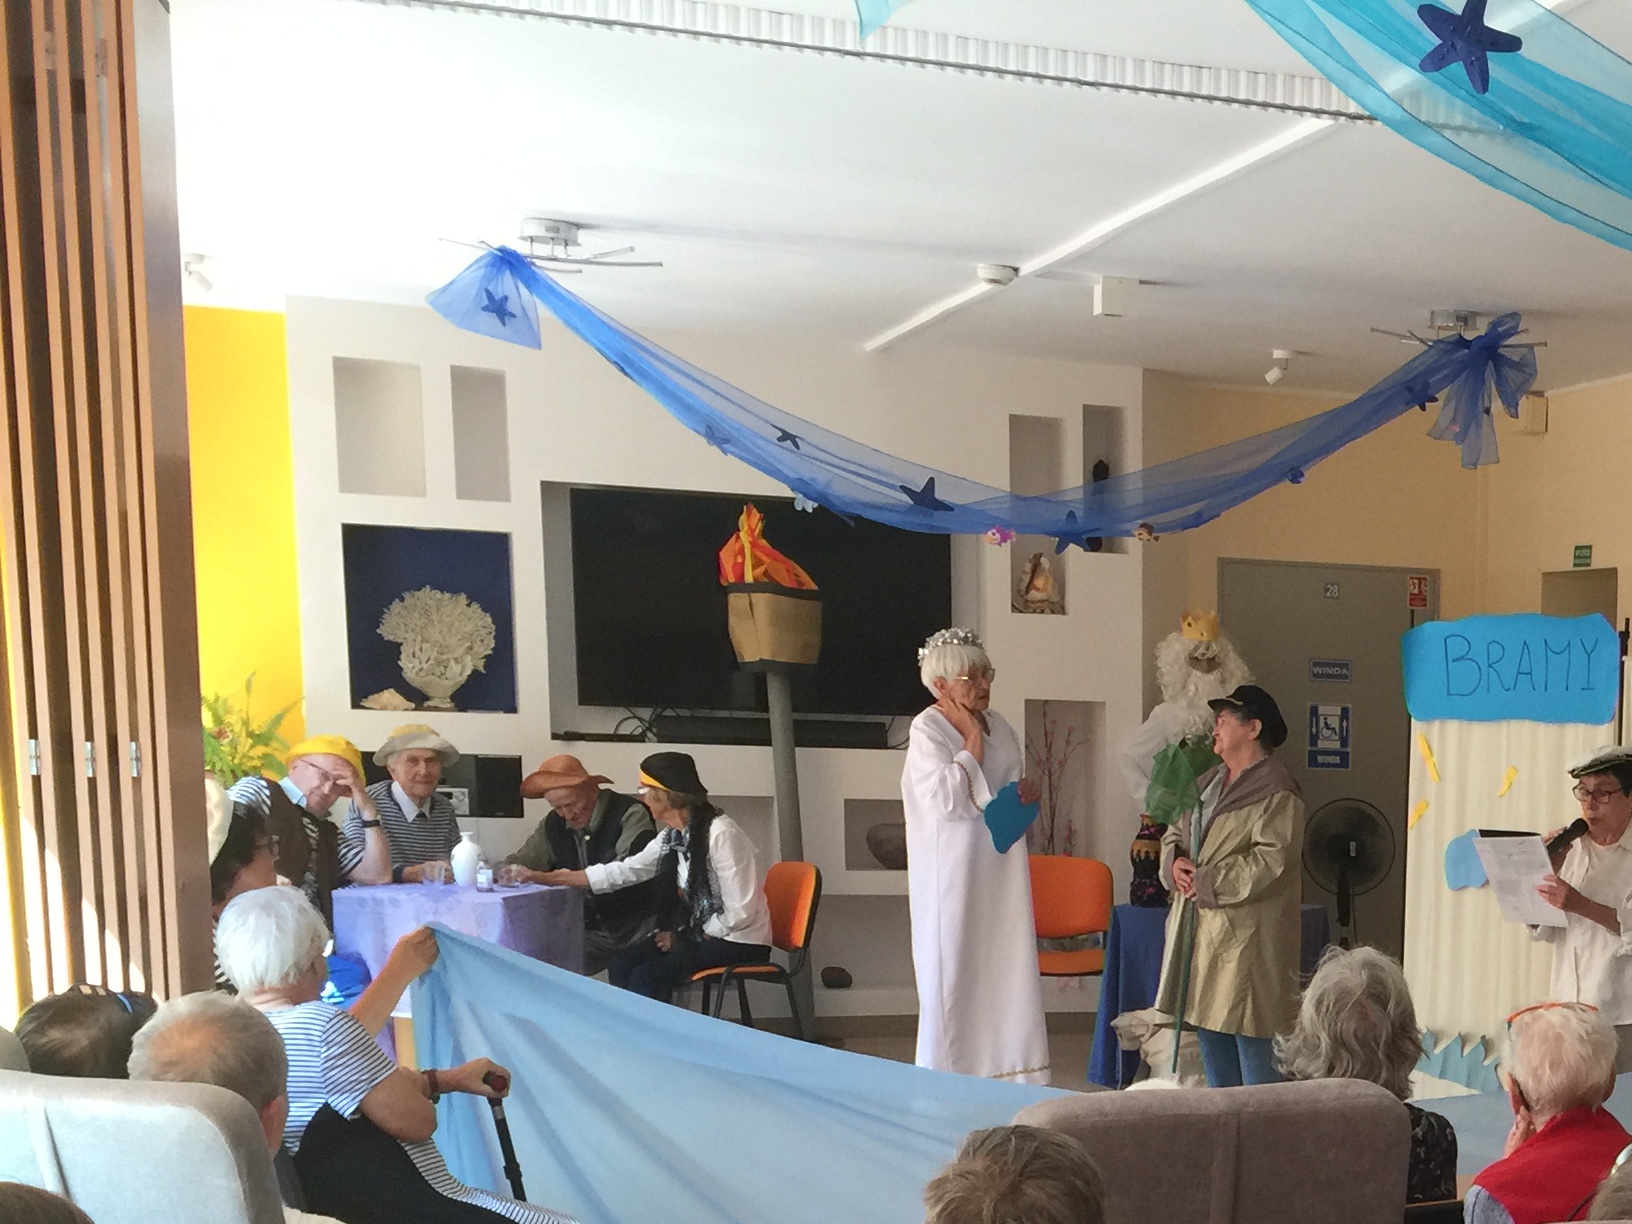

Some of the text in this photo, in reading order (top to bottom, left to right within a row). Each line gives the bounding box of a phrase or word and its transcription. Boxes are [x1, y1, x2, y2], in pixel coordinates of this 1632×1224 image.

[1326, 584, 1338, 598] 28
[1312, 666, 1349, 676] WINDA
[1443, 633, 1599, 697] BRAMY
